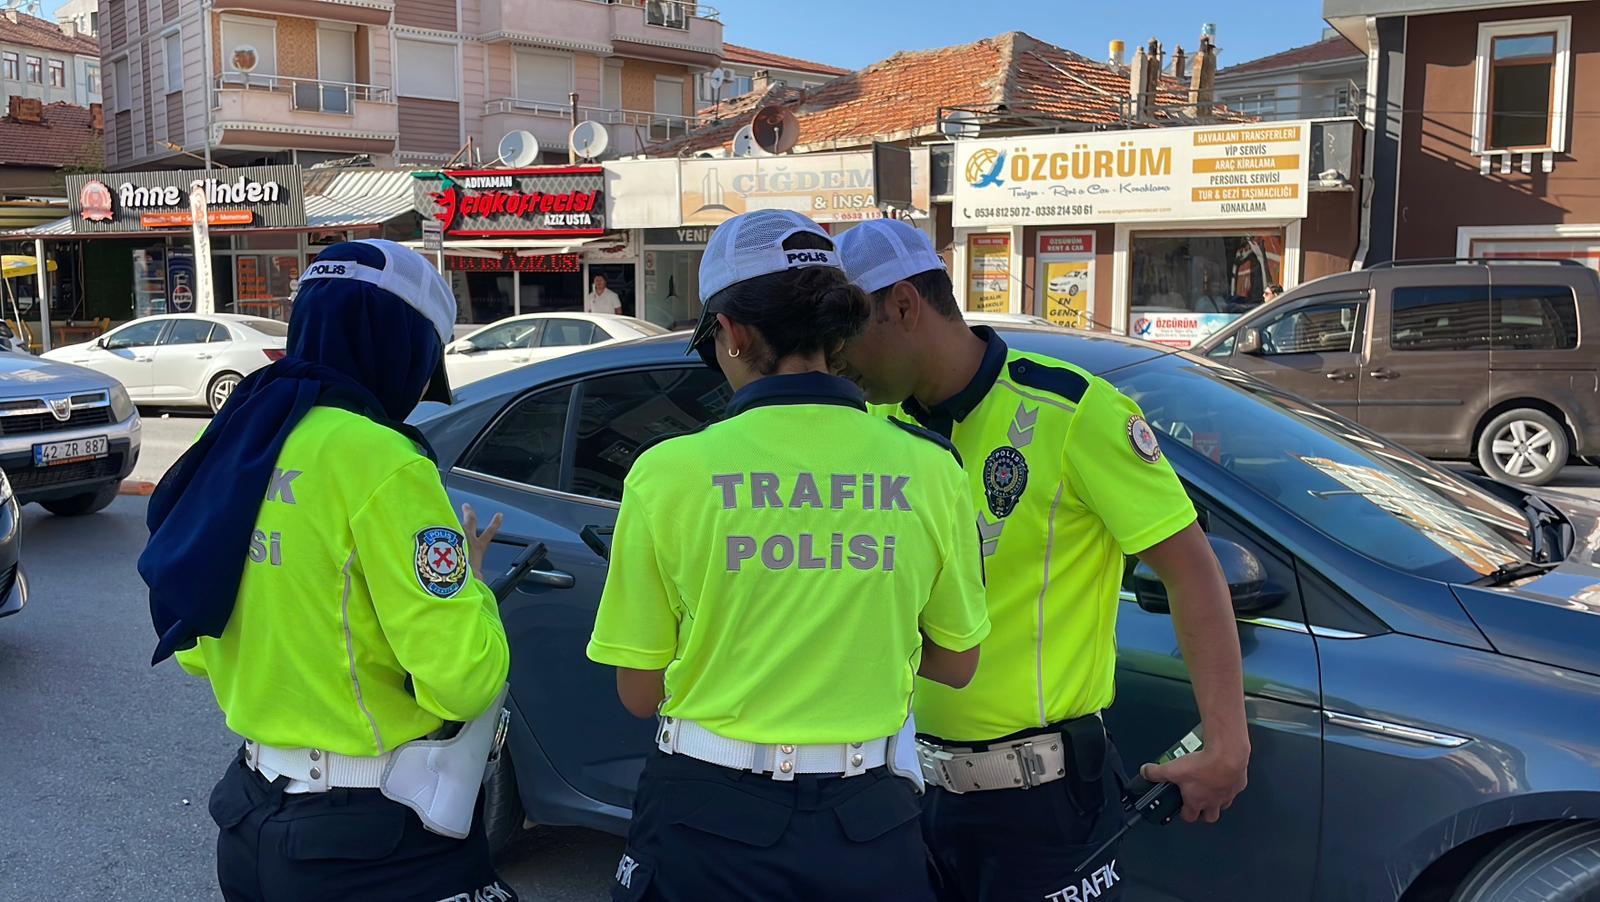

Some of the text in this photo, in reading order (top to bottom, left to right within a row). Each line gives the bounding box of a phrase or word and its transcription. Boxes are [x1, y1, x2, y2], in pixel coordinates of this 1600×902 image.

[1240, 144, 1267, 156] SERVİS
[1010, 141, 1173, 182] ÖZGÜRÜM
[1215, 157, 1276, 171] ARAÇ KİRALAMA
[464, 176, 513, 189] ADIYAMAN
[1210, 174, 1247, 186] PERSONEL
[120, 182, 180, 207] Anne
[1198, 189, 1213, 200] TUR
[814, 196, 827, 210] &
[1220, 201, 1267, 213] KONAKLAMA
[566, 213, 592, 226] USTA
[1058, 297, 1072, 305] EN
[1155, 316, 1198, 328] ÖZGÜRÜM
[43, 445, 58, 460] 42
[65, 442, 79, 457] ZR
[85, 438, 105, 454] 887
